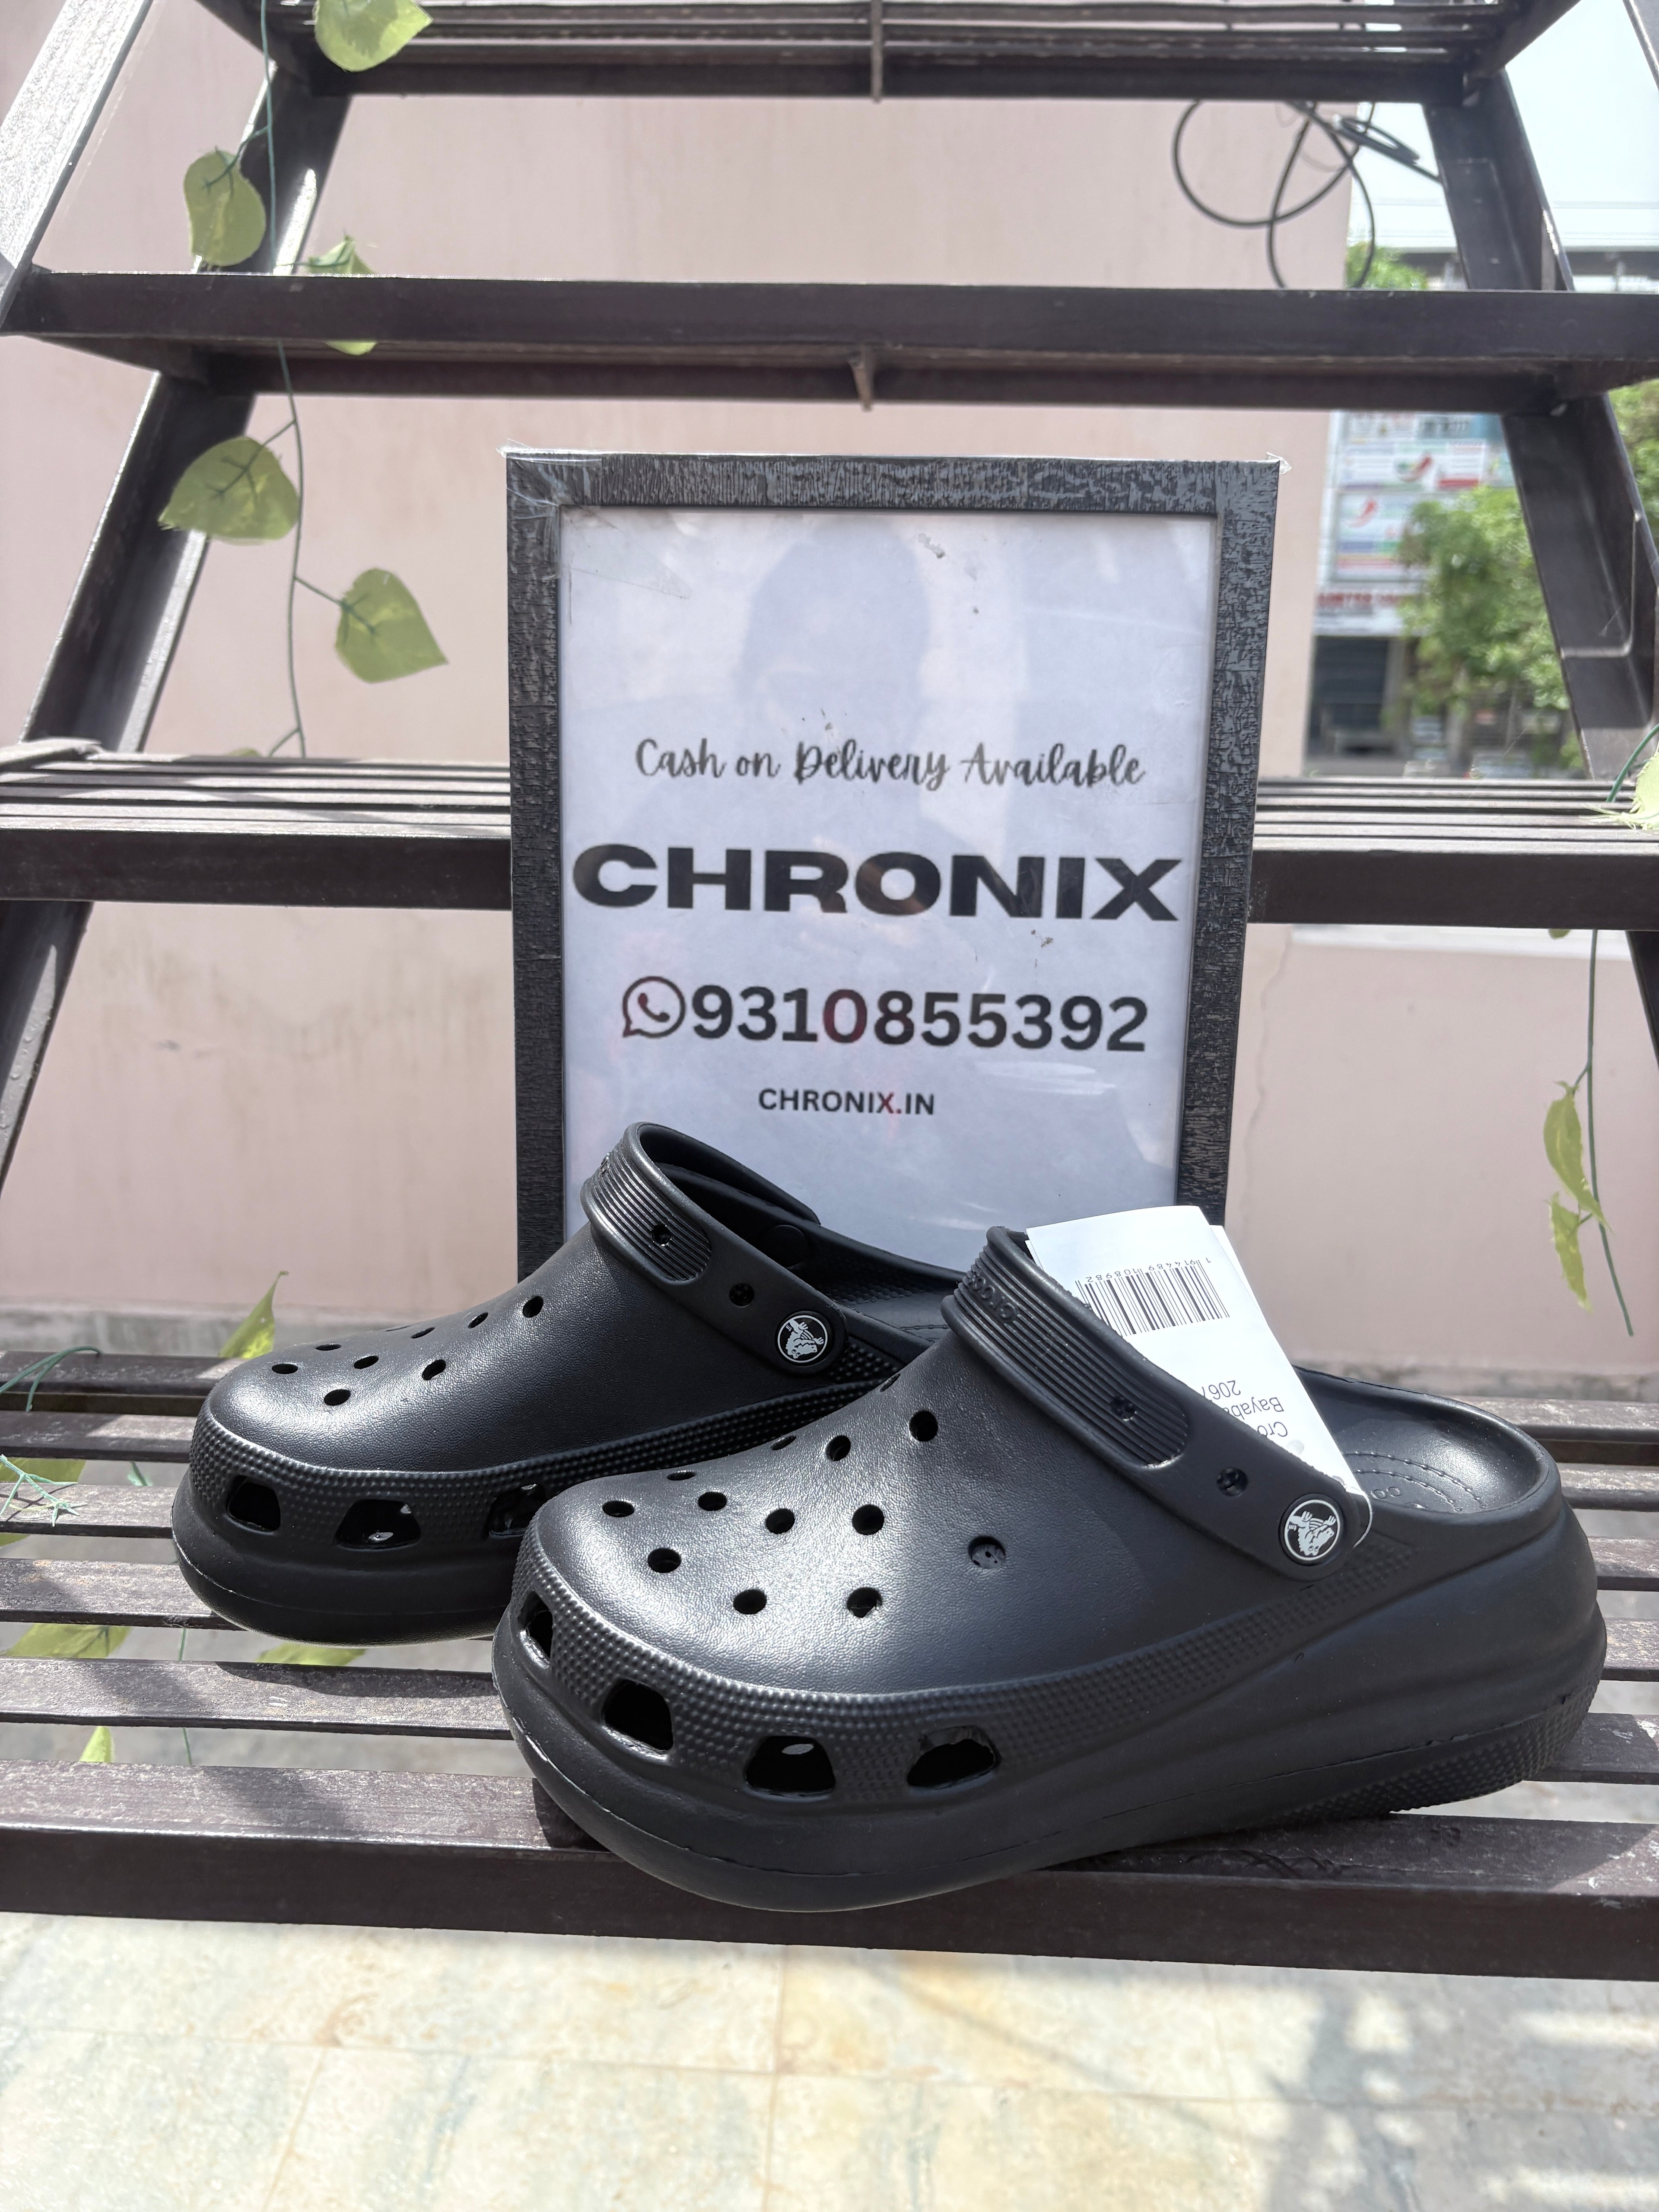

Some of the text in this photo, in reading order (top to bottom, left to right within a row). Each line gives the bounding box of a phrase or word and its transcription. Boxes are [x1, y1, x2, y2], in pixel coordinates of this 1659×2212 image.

[636, 737, 1146, 791] Cash on Delivery Available
[572, 843, 1183, 922] CHRONIX
[691, 984, 1148, 1052] 9310855392
[758, 1087, 935, 1116] CHRONIX.IN
